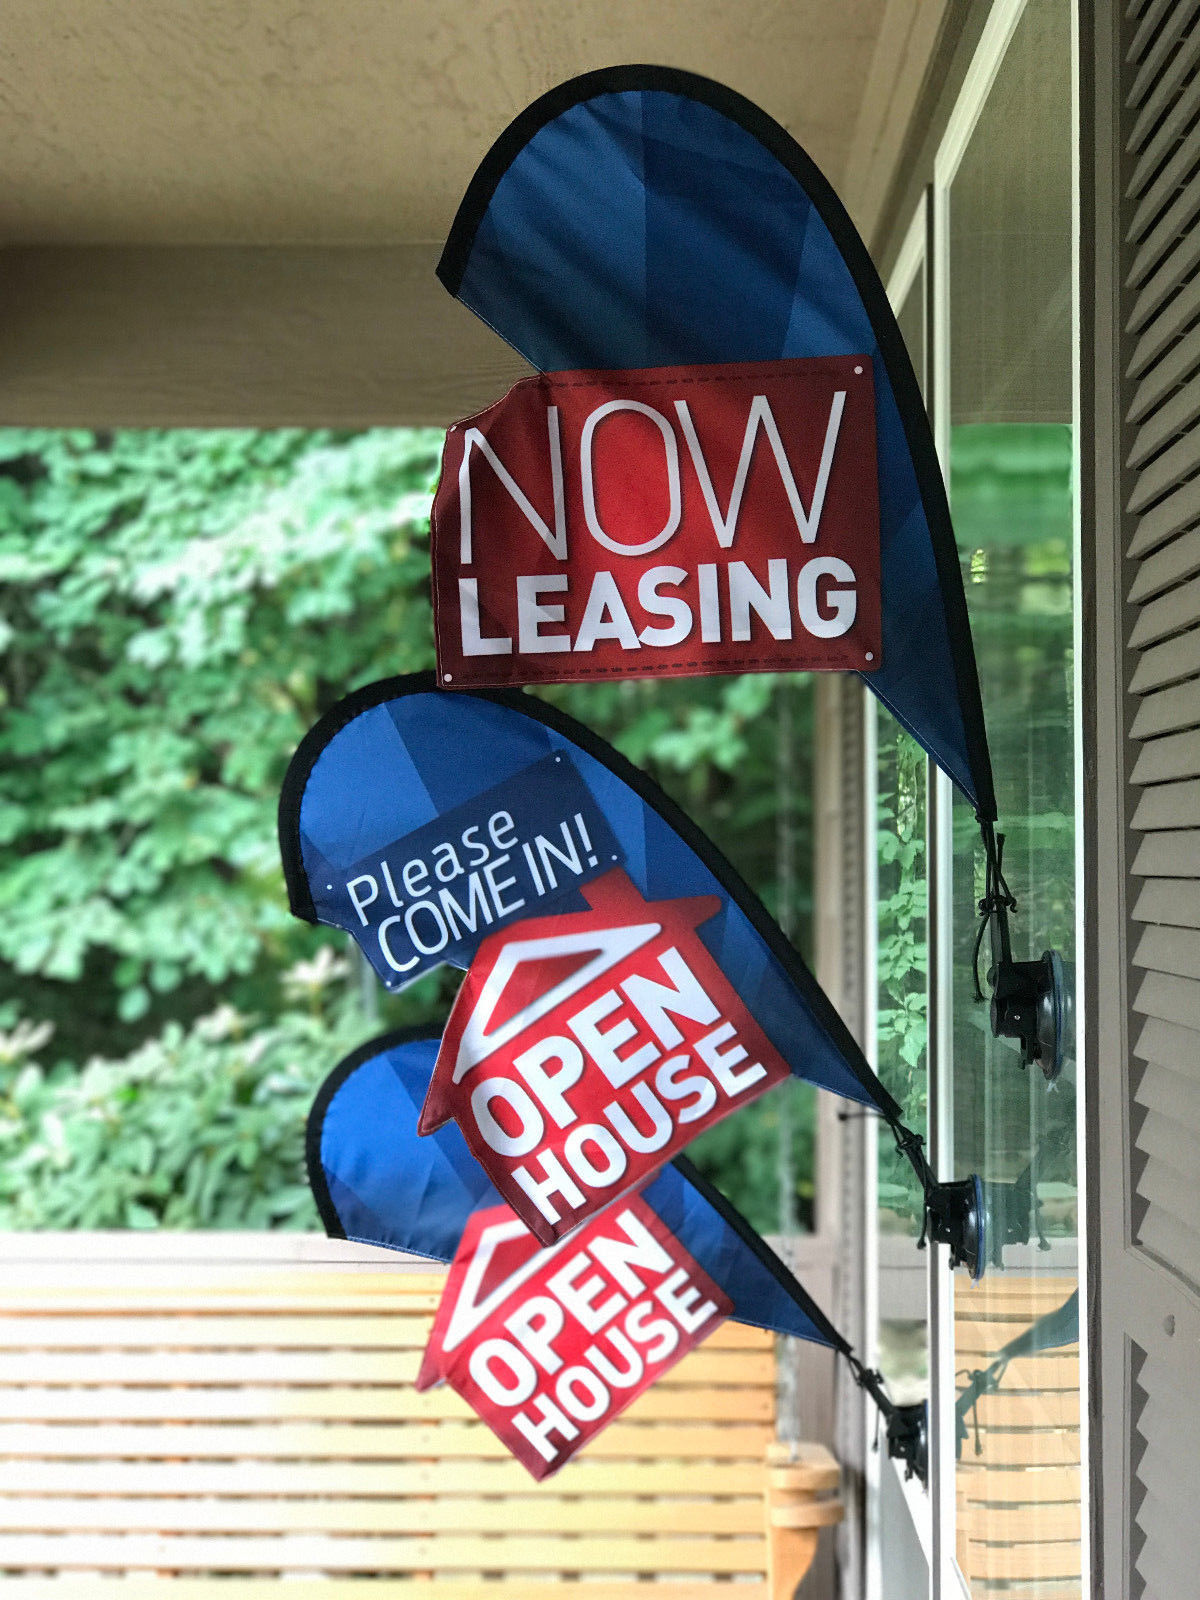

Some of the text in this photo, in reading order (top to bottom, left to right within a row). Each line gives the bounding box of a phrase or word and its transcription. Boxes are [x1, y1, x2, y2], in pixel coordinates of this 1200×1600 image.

[459, 391, 846, 564] NOW
[458, 556, 857, 656] LEASING
[346, 810, 518, 927] Please
[377, 812, 598, 973] COME IN!
[470, 946, 722, 1157] OPEN
[510, 1021, 768, 1226] HOUSE
[468, 1208, 675, 1407] OPEN
[511, 1267, 719, 1463] HOUSE
